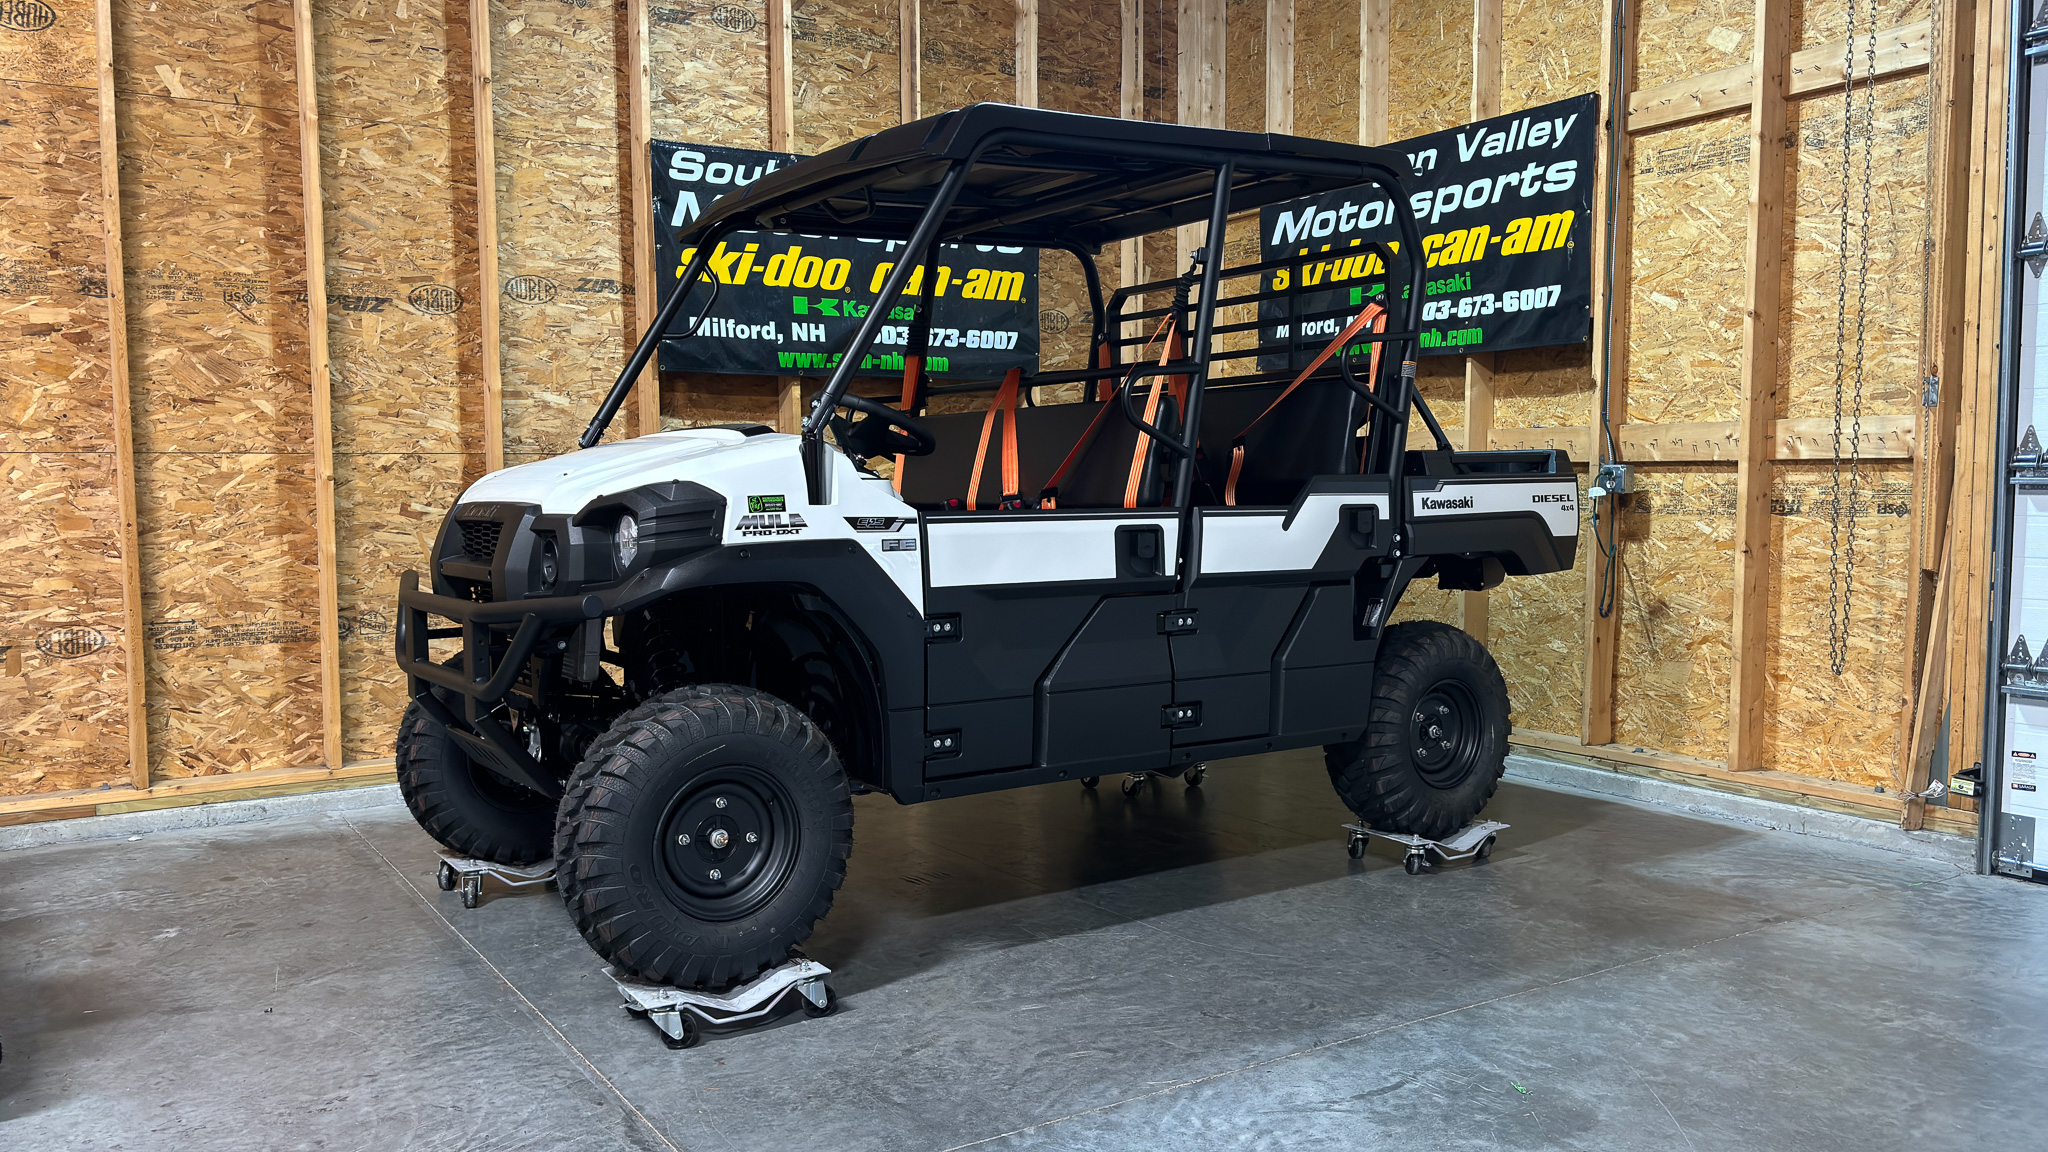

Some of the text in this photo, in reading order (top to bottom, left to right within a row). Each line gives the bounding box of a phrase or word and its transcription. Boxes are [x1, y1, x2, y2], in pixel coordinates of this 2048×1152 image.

[1456, 113, 1579, 163] Valley
[1422, 210, 1576, 268] can-am
[510, 279, 554, 301] HUBER
[1422, 285, 1562, 321] 03-673-6007
[689, 316, 784, 345] Milford,
[791, 322, 826, 342] NH
[1421, 496, 1474, 510] Kawasaki
[1532, 494, 1575, 503] DIESEL
[735, 513, 809, 531] MULE
[742, 529, 802, 537] PRO-DXT
[888, 540, 916, 550] FE
